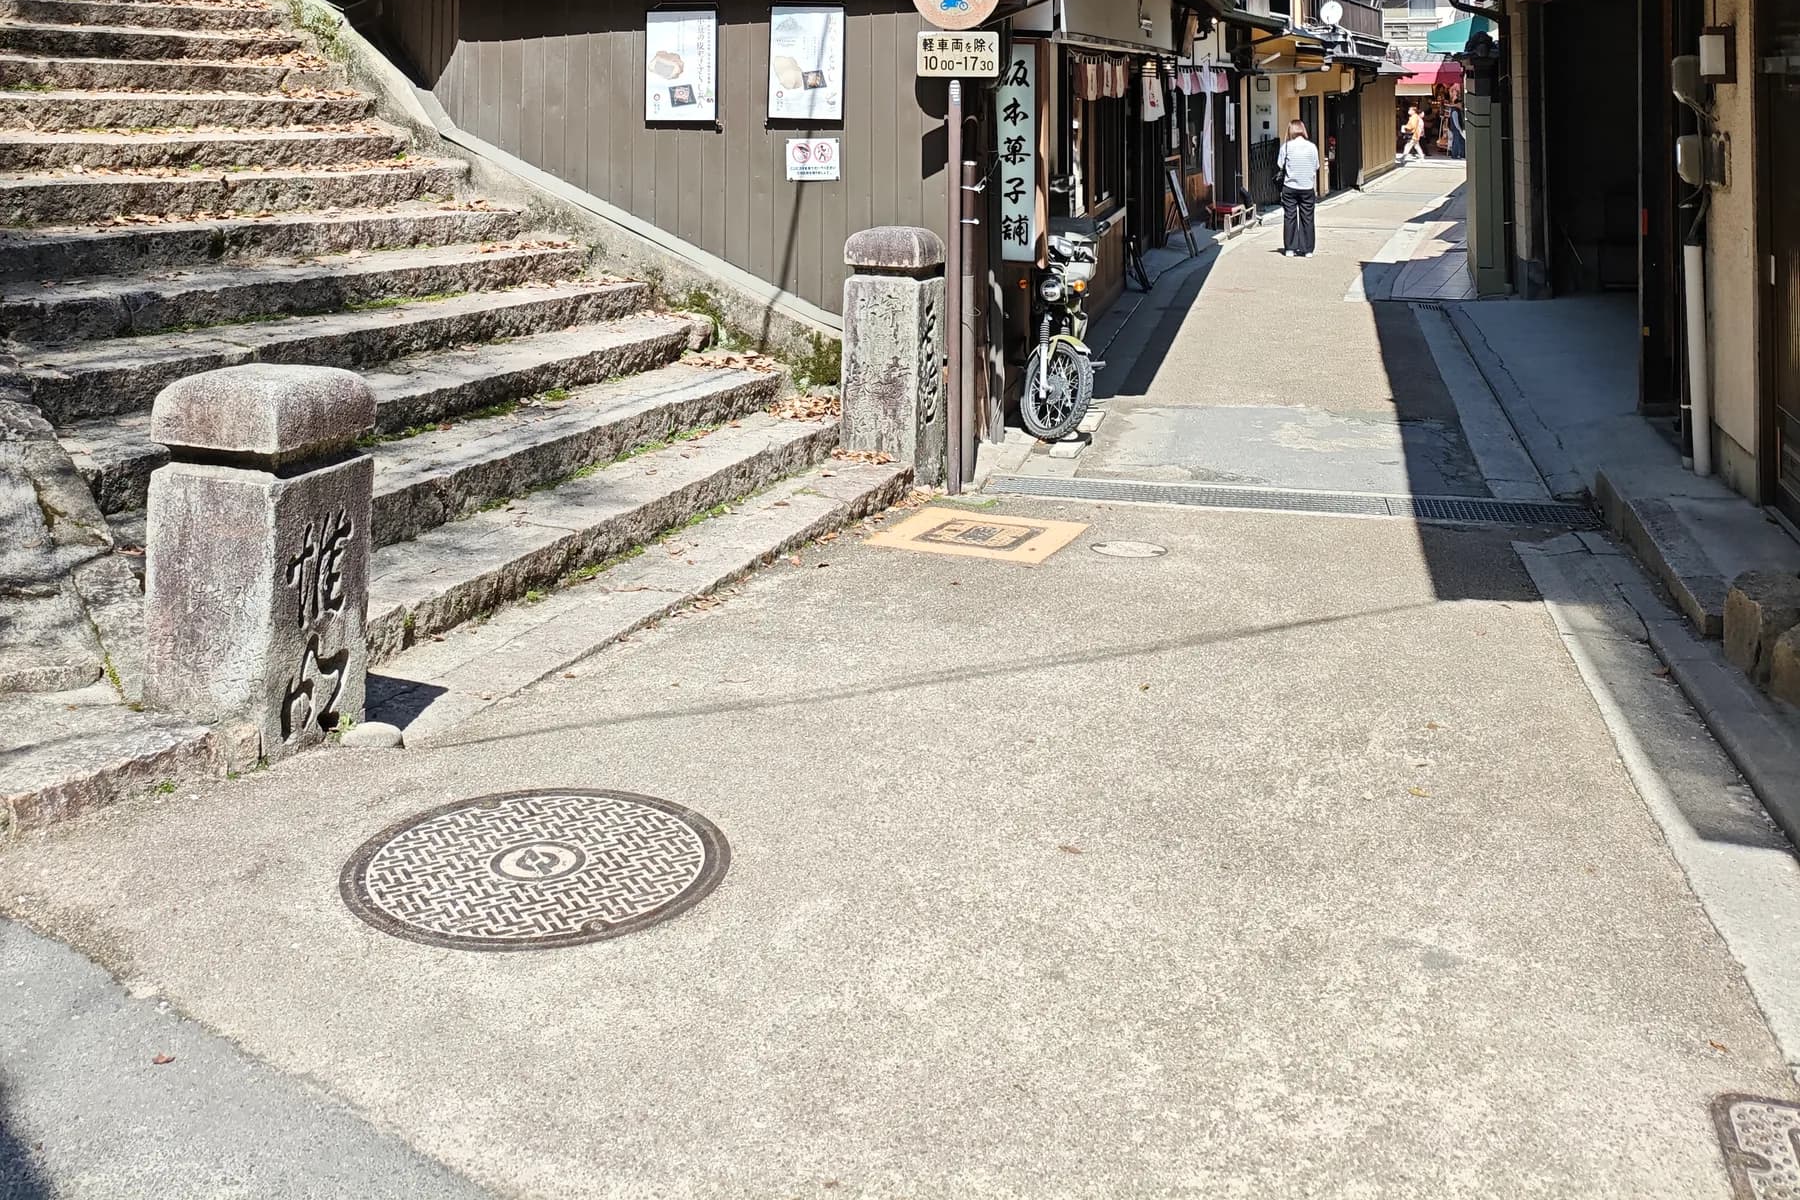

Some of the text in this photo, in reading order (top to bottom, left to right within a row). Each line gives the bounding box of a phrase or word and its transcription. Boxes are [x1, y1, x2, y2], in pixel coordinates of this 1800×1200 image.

[922, 38, 994, 53] 軽車両を除く
[997, 59, 1032, 247] 坂本菓子舗
